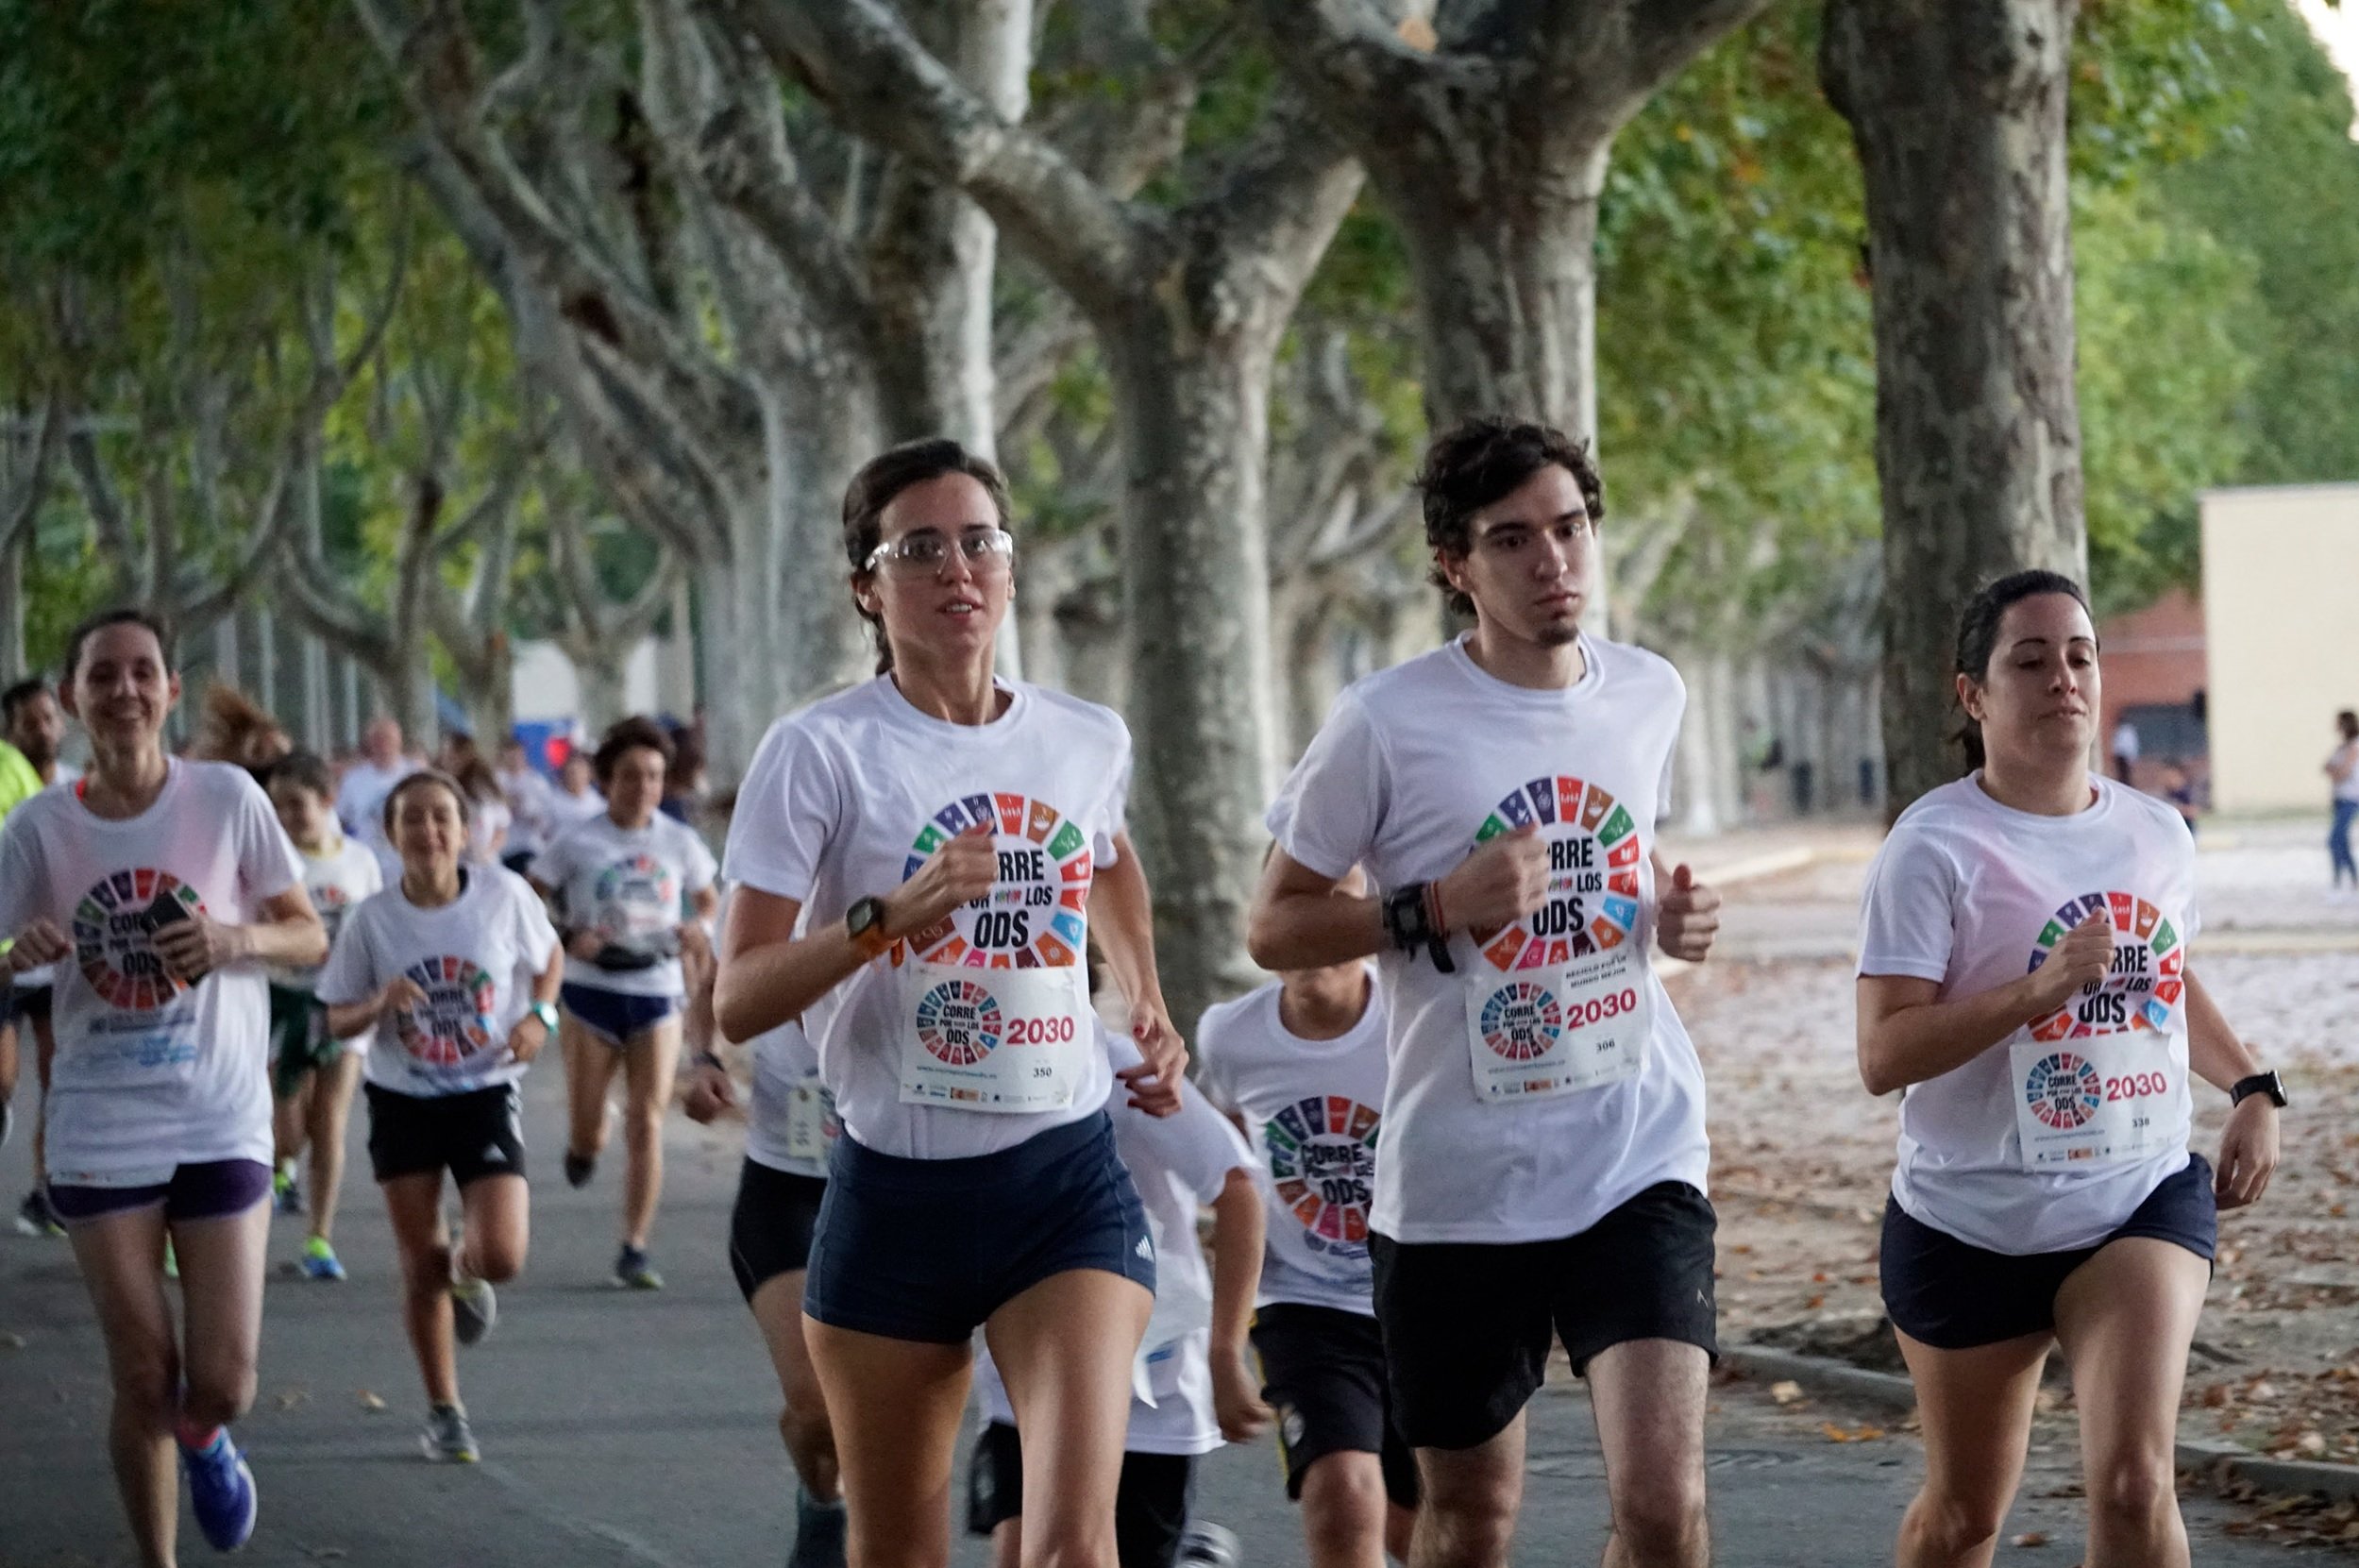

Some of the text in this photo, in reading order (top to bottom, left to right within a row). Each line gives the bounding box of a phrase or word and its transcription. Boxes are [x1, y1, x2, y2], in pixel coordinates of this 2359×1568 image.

[1549, 836, 1594, 870] RRE
[999, 849, 1045, 882] RRE
[1576, 871, 1603, 893] LOS
[1025, 885, 1053, 906] LOS
[973, 909, 1029, 949] ODS
[2111, 945, 2148, 973] RRE
[2125, 976, 2152, 993] LOS
[942, 1003, 976, 1020] CORRE
[1504, 1003, 1536, 1020] CORRE
[1567, 987, 1637, 1032] 2030
[946, 1027, 970, 1046] ODS
[1006, 1016, 1075, 1045] 2030
[1510, 1027, 1535, 1044] ODS
[1034, 1066, 1053, 1078] 350
[2047, 1074, 2077, 1088] CORRE
[2106, 1071, 2168, 1103] 2030
[2054, 1095, 2077, 1112] ODS
[1322, 1178, 1371, 1206] ODS
